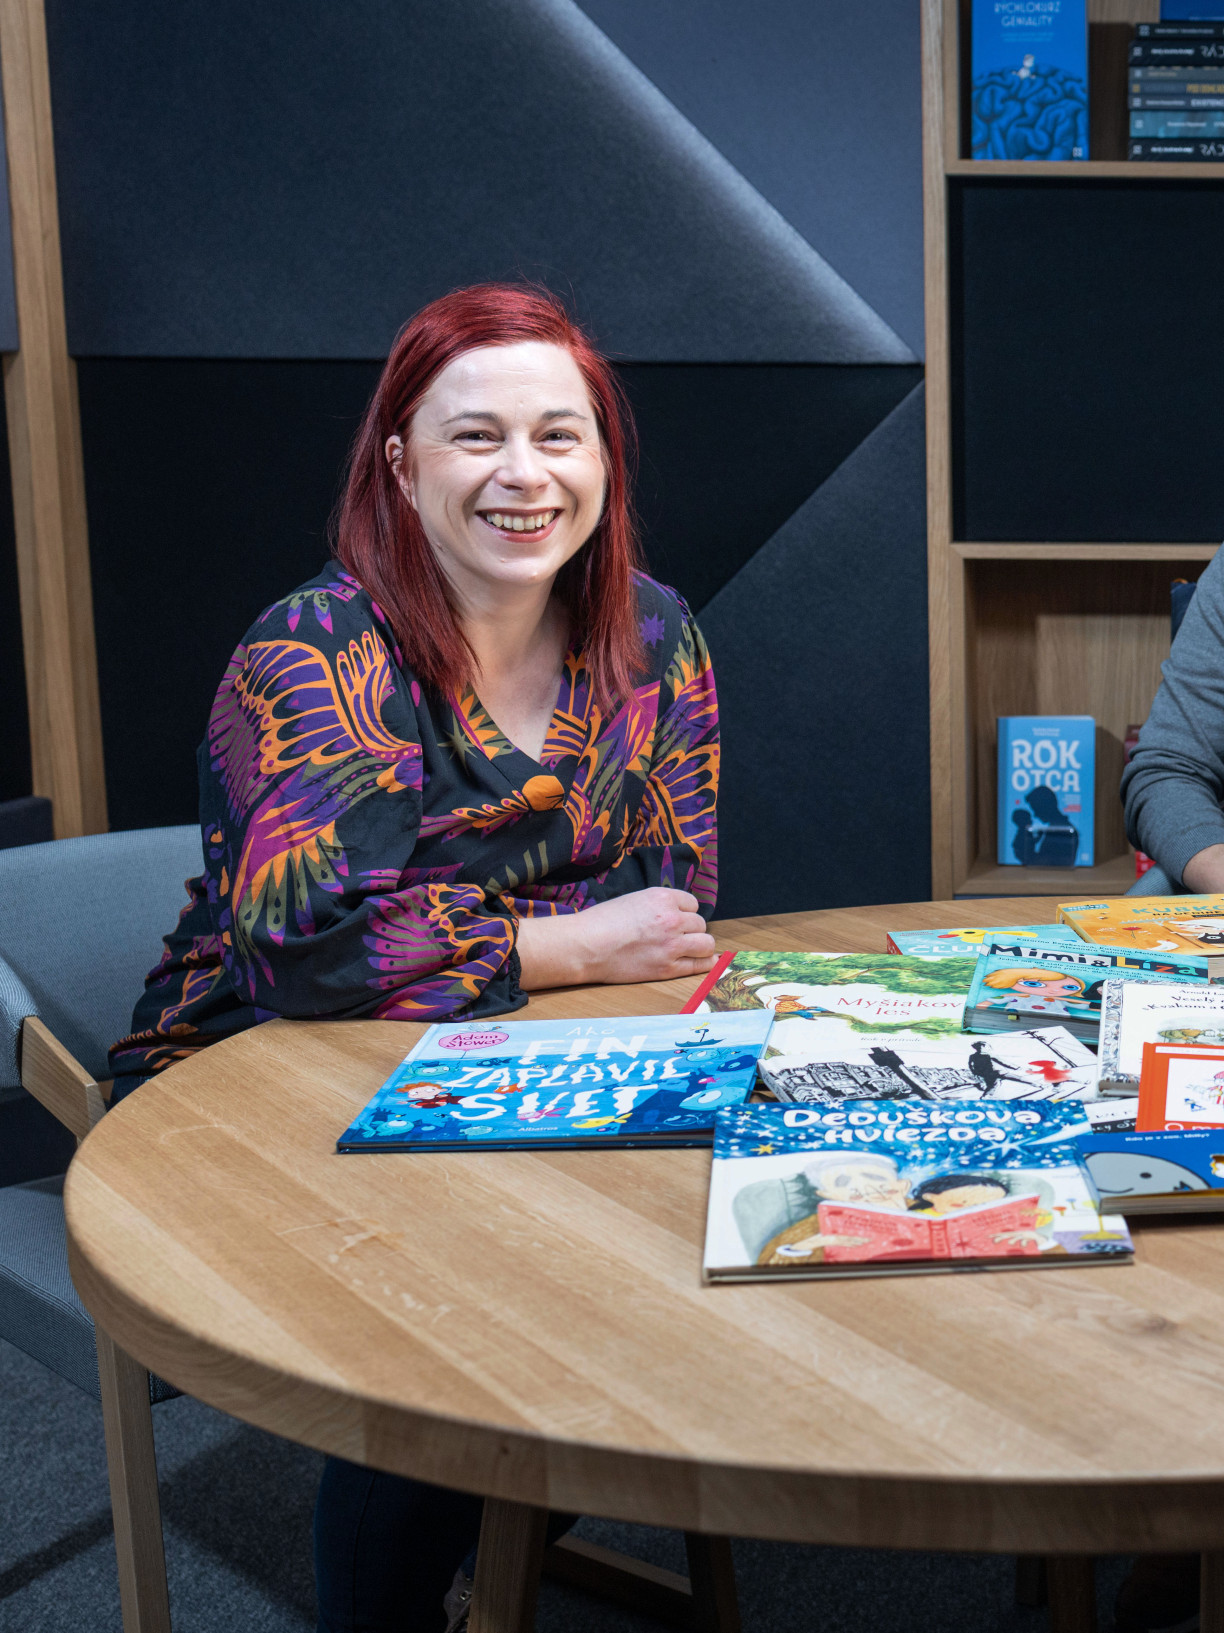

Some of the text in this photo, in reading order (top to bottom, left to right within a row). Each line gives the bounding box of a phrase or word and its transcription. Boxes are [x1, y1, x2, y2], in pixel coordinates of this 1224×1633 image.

[1001, 15, 1053, 27] GENIALITY
[1011, 739, 1082, 770] ROK
[1011, 769, 1081, 792] OTCA
[990, 943, 1199, 976] Mimi & Líza
[837, 997, 963, 1009] Myšiakov
[876, 1007, 911, 1016] les
[452, 1034, 499, 1042] Adam
[566, 1026, 616, 1037] Ako
[446, 1038, 503, 1048] Stower
[518, 1035, 648, 1065] FIN
[442, 1057, 691, 1088] ZAPLAVIL
[449, 1084, 659, 1123] SVET
